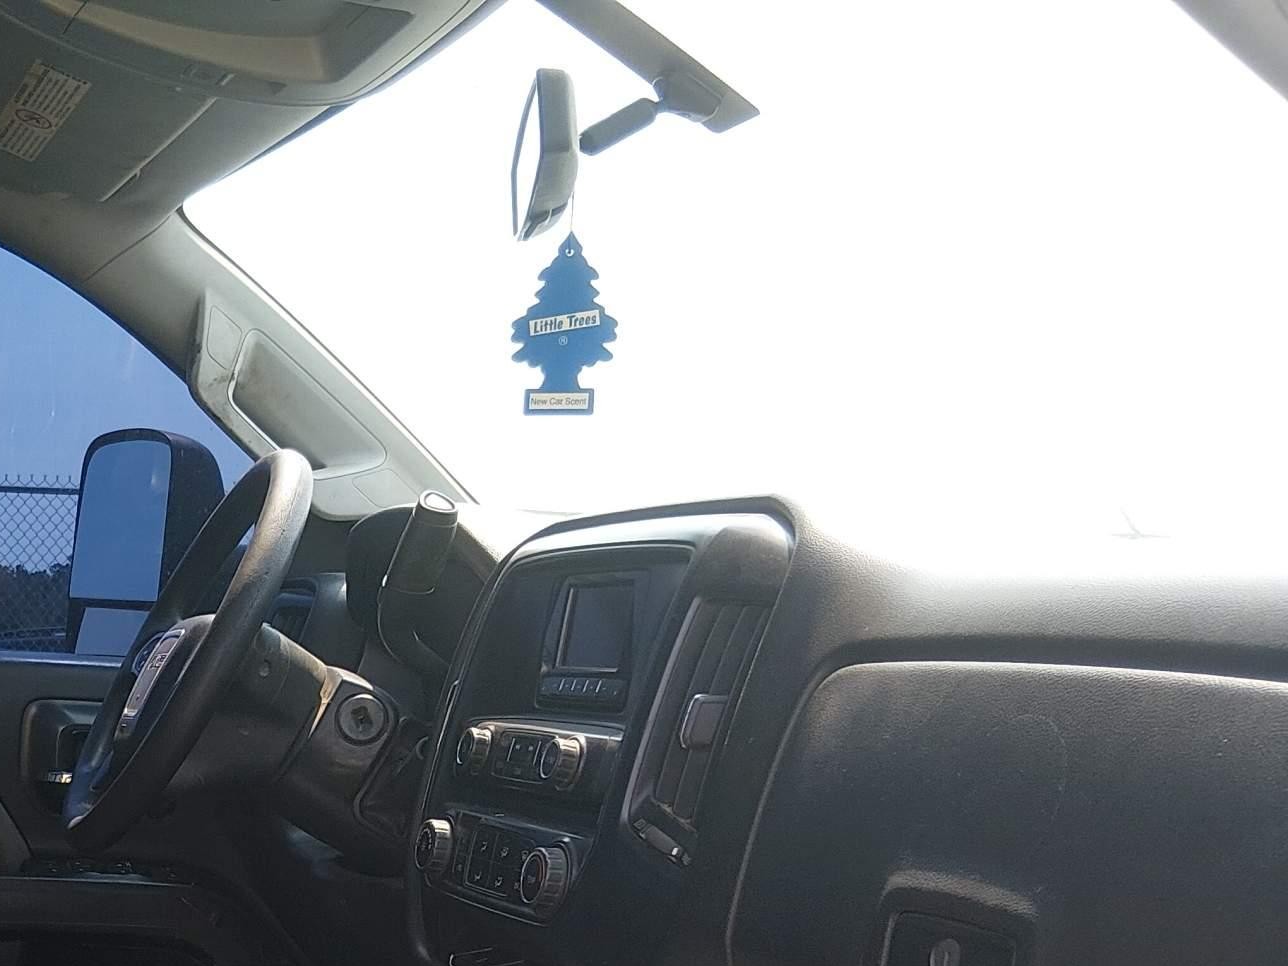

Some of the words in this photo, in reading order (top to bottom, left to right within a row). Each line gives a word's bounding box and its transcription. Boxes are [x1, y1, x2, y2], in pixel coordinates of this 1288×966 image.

[533, 318, 563, 333] Little
[567, 315, 597, 328] Trees
[531, 397, 547, 405] New
[549, 397, 563, 405] Car
[565, 397, 587, 405] Scent
